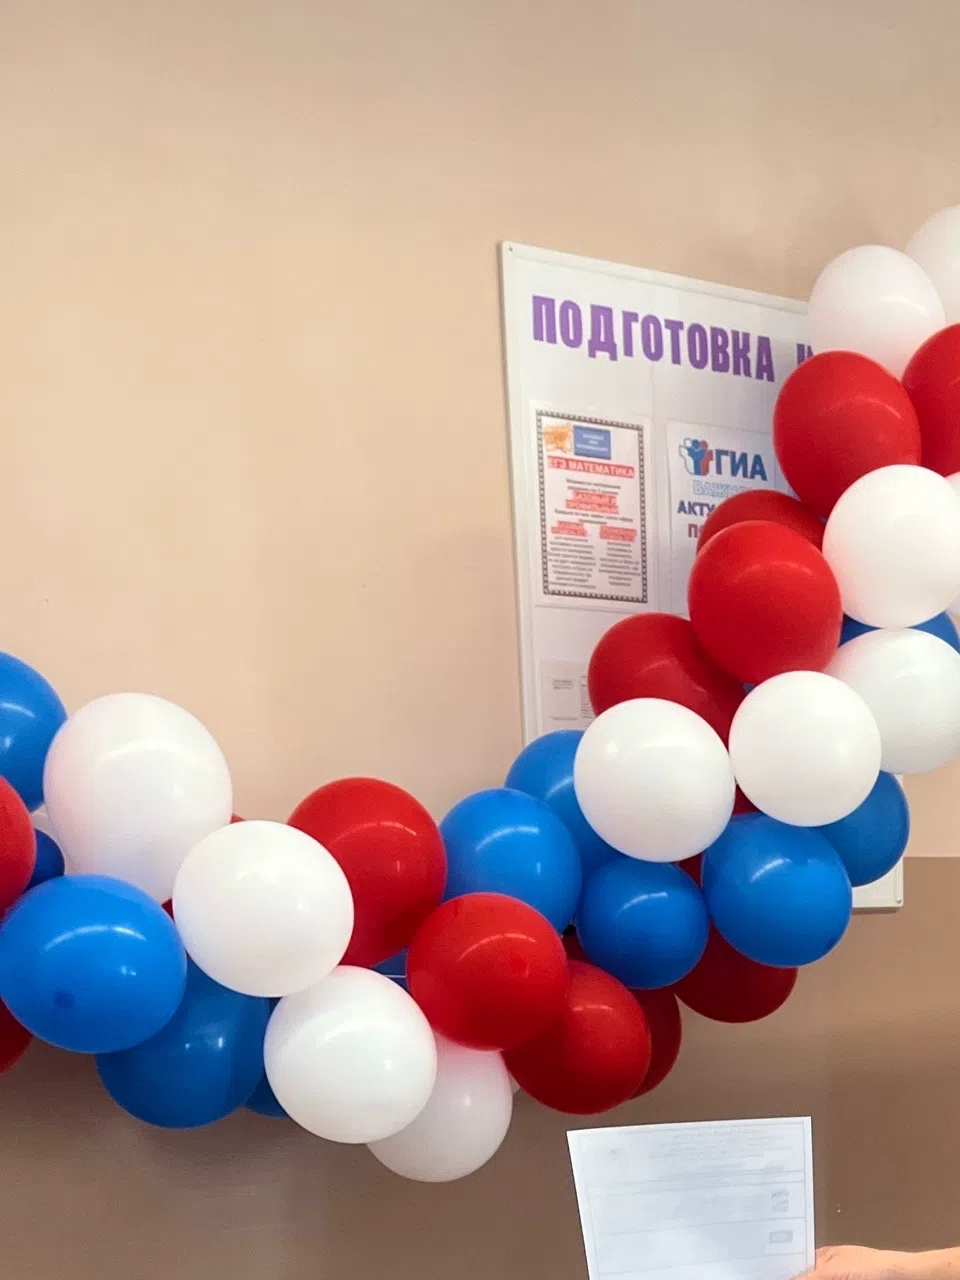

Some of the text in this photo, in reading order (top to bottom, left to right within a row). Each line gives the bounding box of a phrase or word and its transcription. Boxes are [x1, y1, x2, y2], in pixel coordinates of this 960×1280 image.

[532, 295, 775, 382] ПОДГОТОВКА
[568, 459, 634, 477] МАТЕМАТИКА
[715, 448, 768, 481] ГИА
[677, 500, 715, 516] АКТУ
